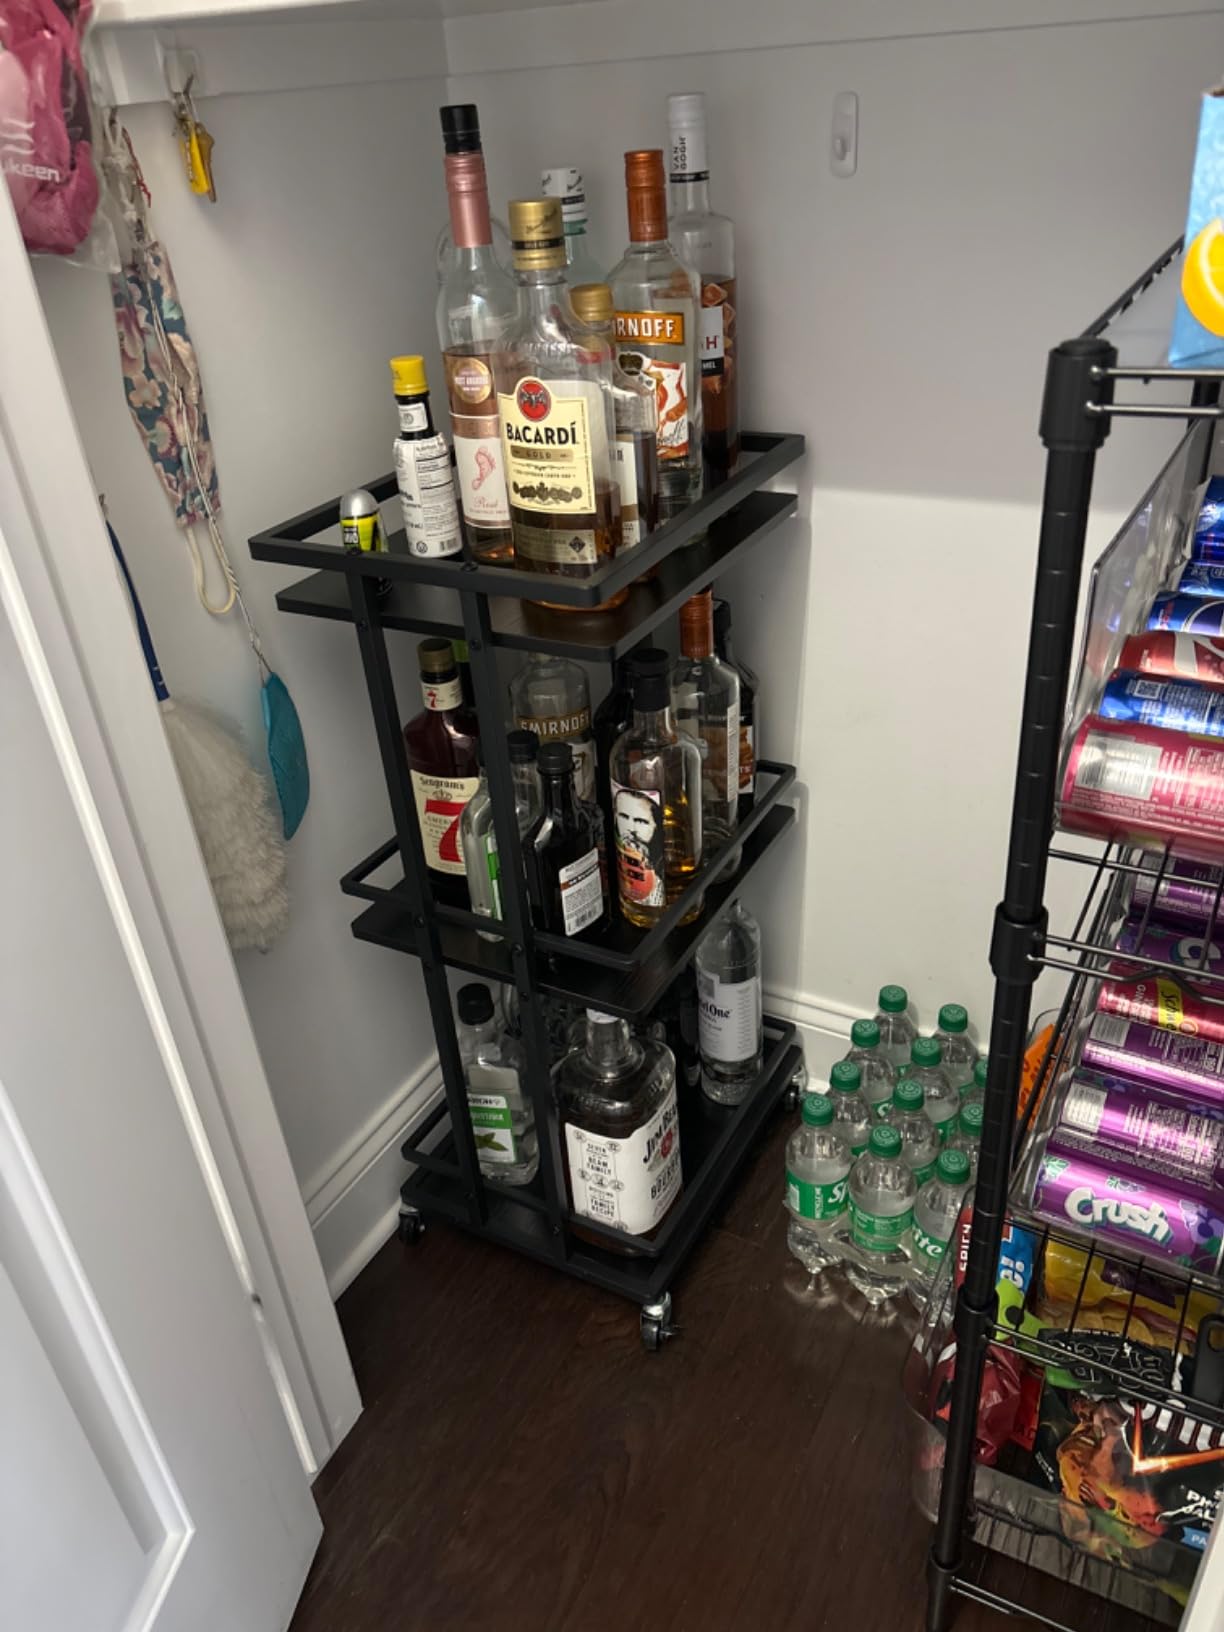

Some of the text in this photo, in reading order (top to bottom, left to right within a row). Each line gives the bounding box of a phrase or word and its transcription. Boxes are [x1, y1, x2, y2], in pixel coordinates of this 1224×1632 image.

[614, 317, 675, 338] RNOFF
[505, 421, 577, 445] BACARDÍ
[709, 1003, 731, 1018] One
[1064, 1186, 1173, 1246] Crush
